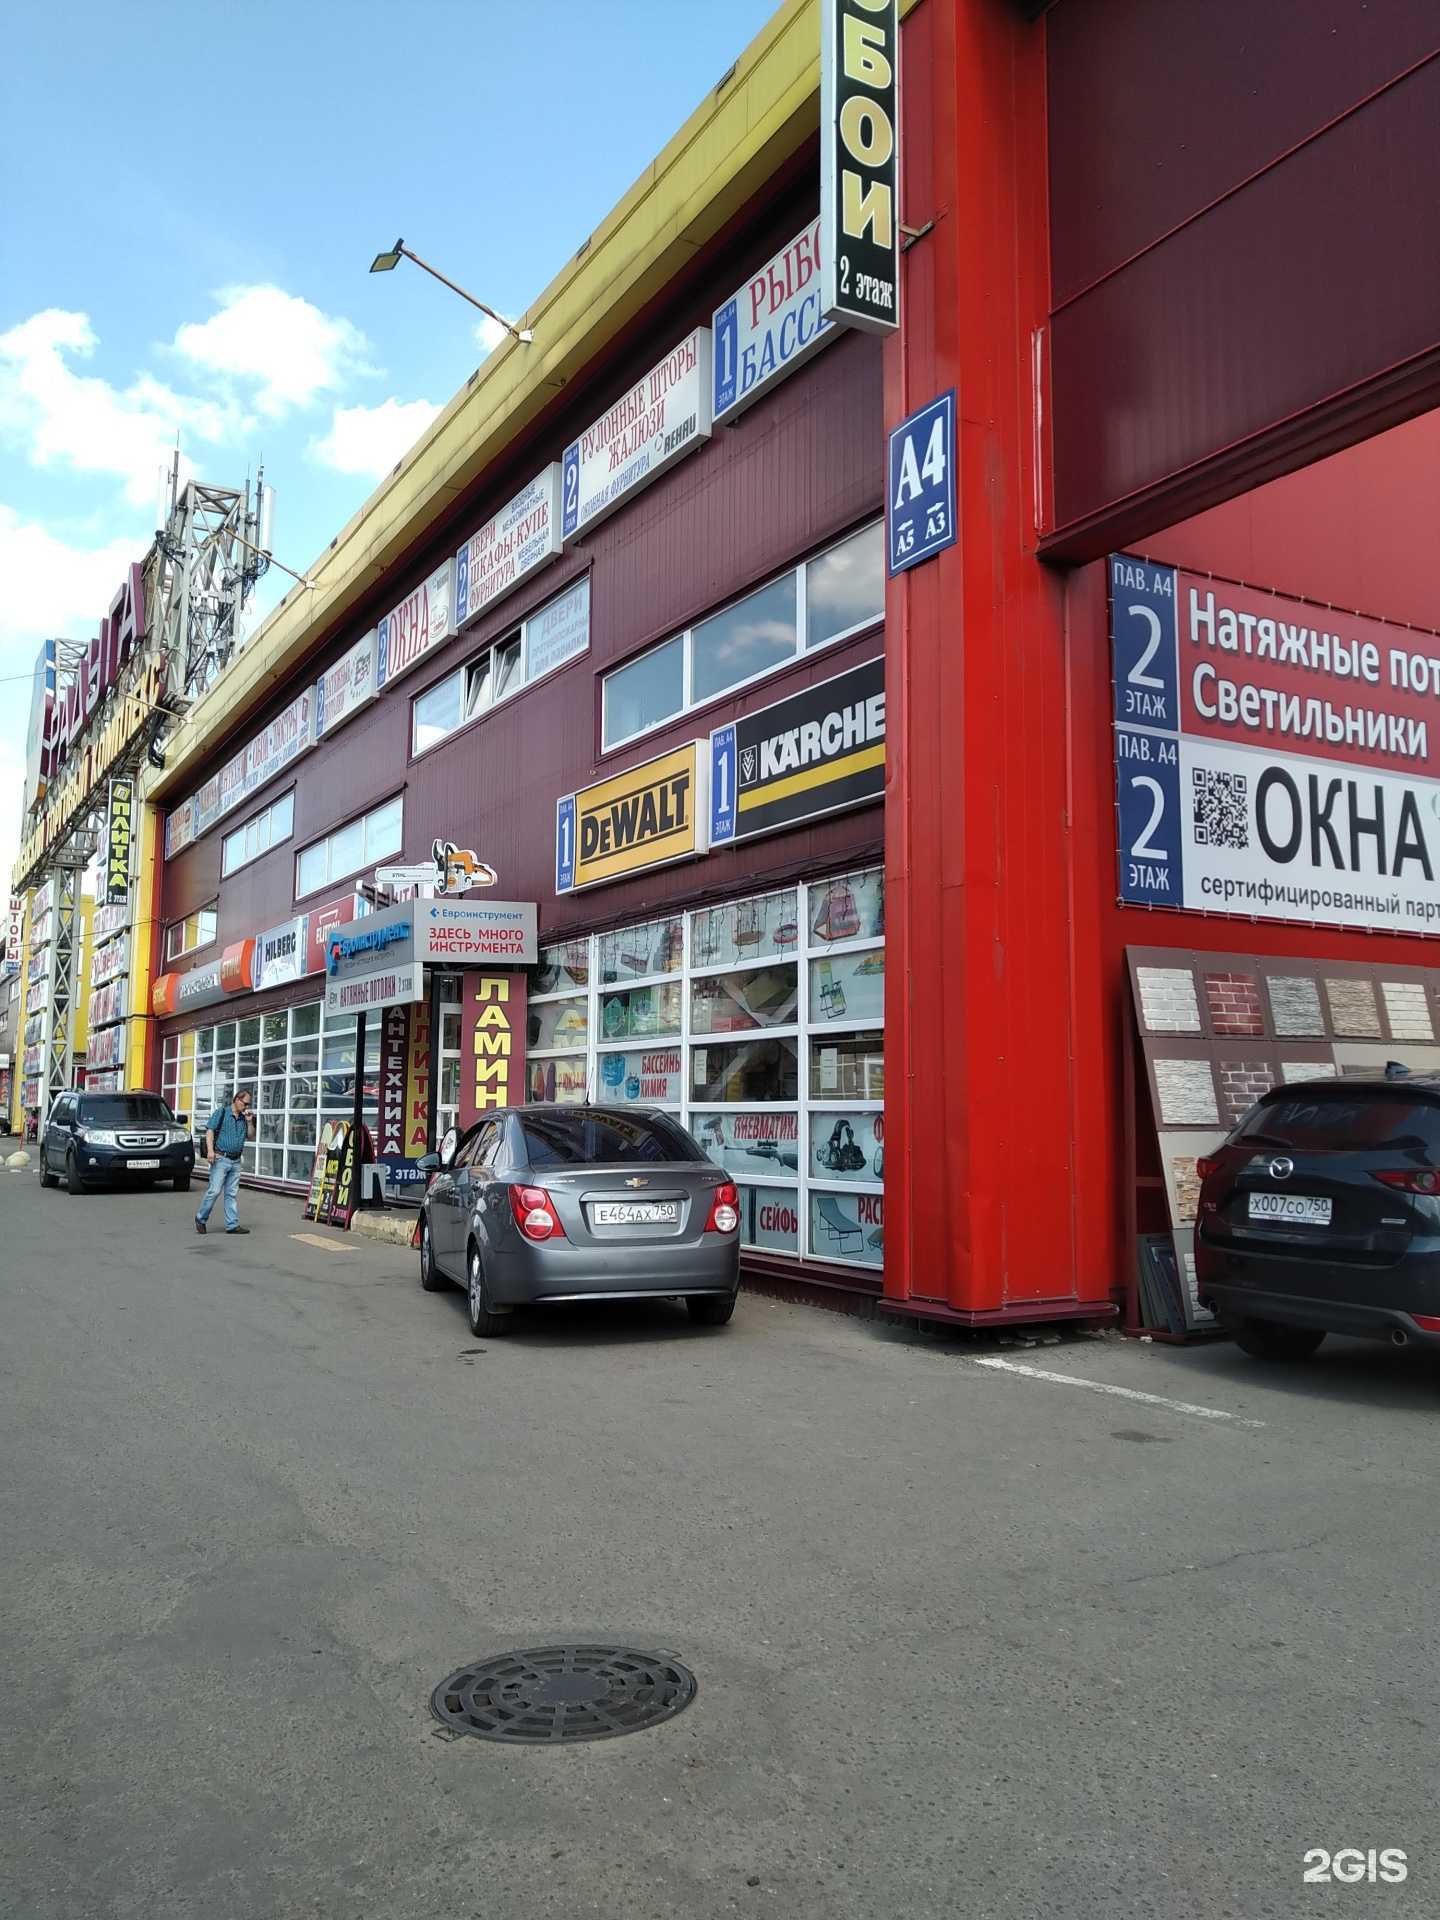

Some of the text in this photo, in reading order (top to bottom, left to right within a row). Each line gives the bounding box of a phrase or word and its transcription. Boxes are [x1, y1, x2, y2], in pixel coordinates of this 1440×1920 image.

[839, 0, 893, 250] БОИ
[840, 255, 894, 309] 2 этаж
[721, 324, 733, 386] 1
[581, 336, 697, 465] РУЛОННЫЕ ШТОРЫ
[608, 399, 665, 473] ЖАЛЮЗИ
[664, 412, 697, 455] REHAU
[566, 462, 578, 512] 2
[610, 455, 650, 499] ФУРНИТУРА
[894, 415, 946, 510] А4
[470, 520, 496, 562] ДВЕРИ
[896, 511, 946, 557] А5 А3
[458, 562, 467, 606] 2
[469, 556, 516, 612] ФУРНИТУРА
[1113, 562, 1173, 598] ПАВ. А4
[387, 584, 430, 678] ОКНА
[1127, 604, 1164, 689] 2
[1189, 587, 1380, 682] Натяжные
[1125, 689, 1167, 719] ЭТАЖ
[1192, 662, 1428, 758] Светильники
[1118, 733, 1178, 766] ПАВ. А4
[718, 751, 730, 814] 1
[562, 816, 571, 868] 1
[1130, 775, 1168, 861] 2
[1255, 766, 1435, 882] ОКНА
[108, 802, 130, 887] ПЛИТКА
[1128, 863, 1170, 891] ЭТАЖ
[1201, 874, 1401, 916] сертифицированный
[7, 900, 22, 960] ШТОРЫ
[429, 927, 524, 941] ЗДЕСЬ МНОГО
[442, 908, 524, 921] Евроинструмент
[265, 931, 297, 963] HILBERG
[429, 941, 525, 954] ИНСТРУМЕНТА
[369, 975, 396, 1003] ПОТОЛКИ
[410, 1001, 428, 1146] ПЛИТКА
[640, 1078, 668, 1098] ХИМИЯ
[395, 1169, 426, 1180] этаж
